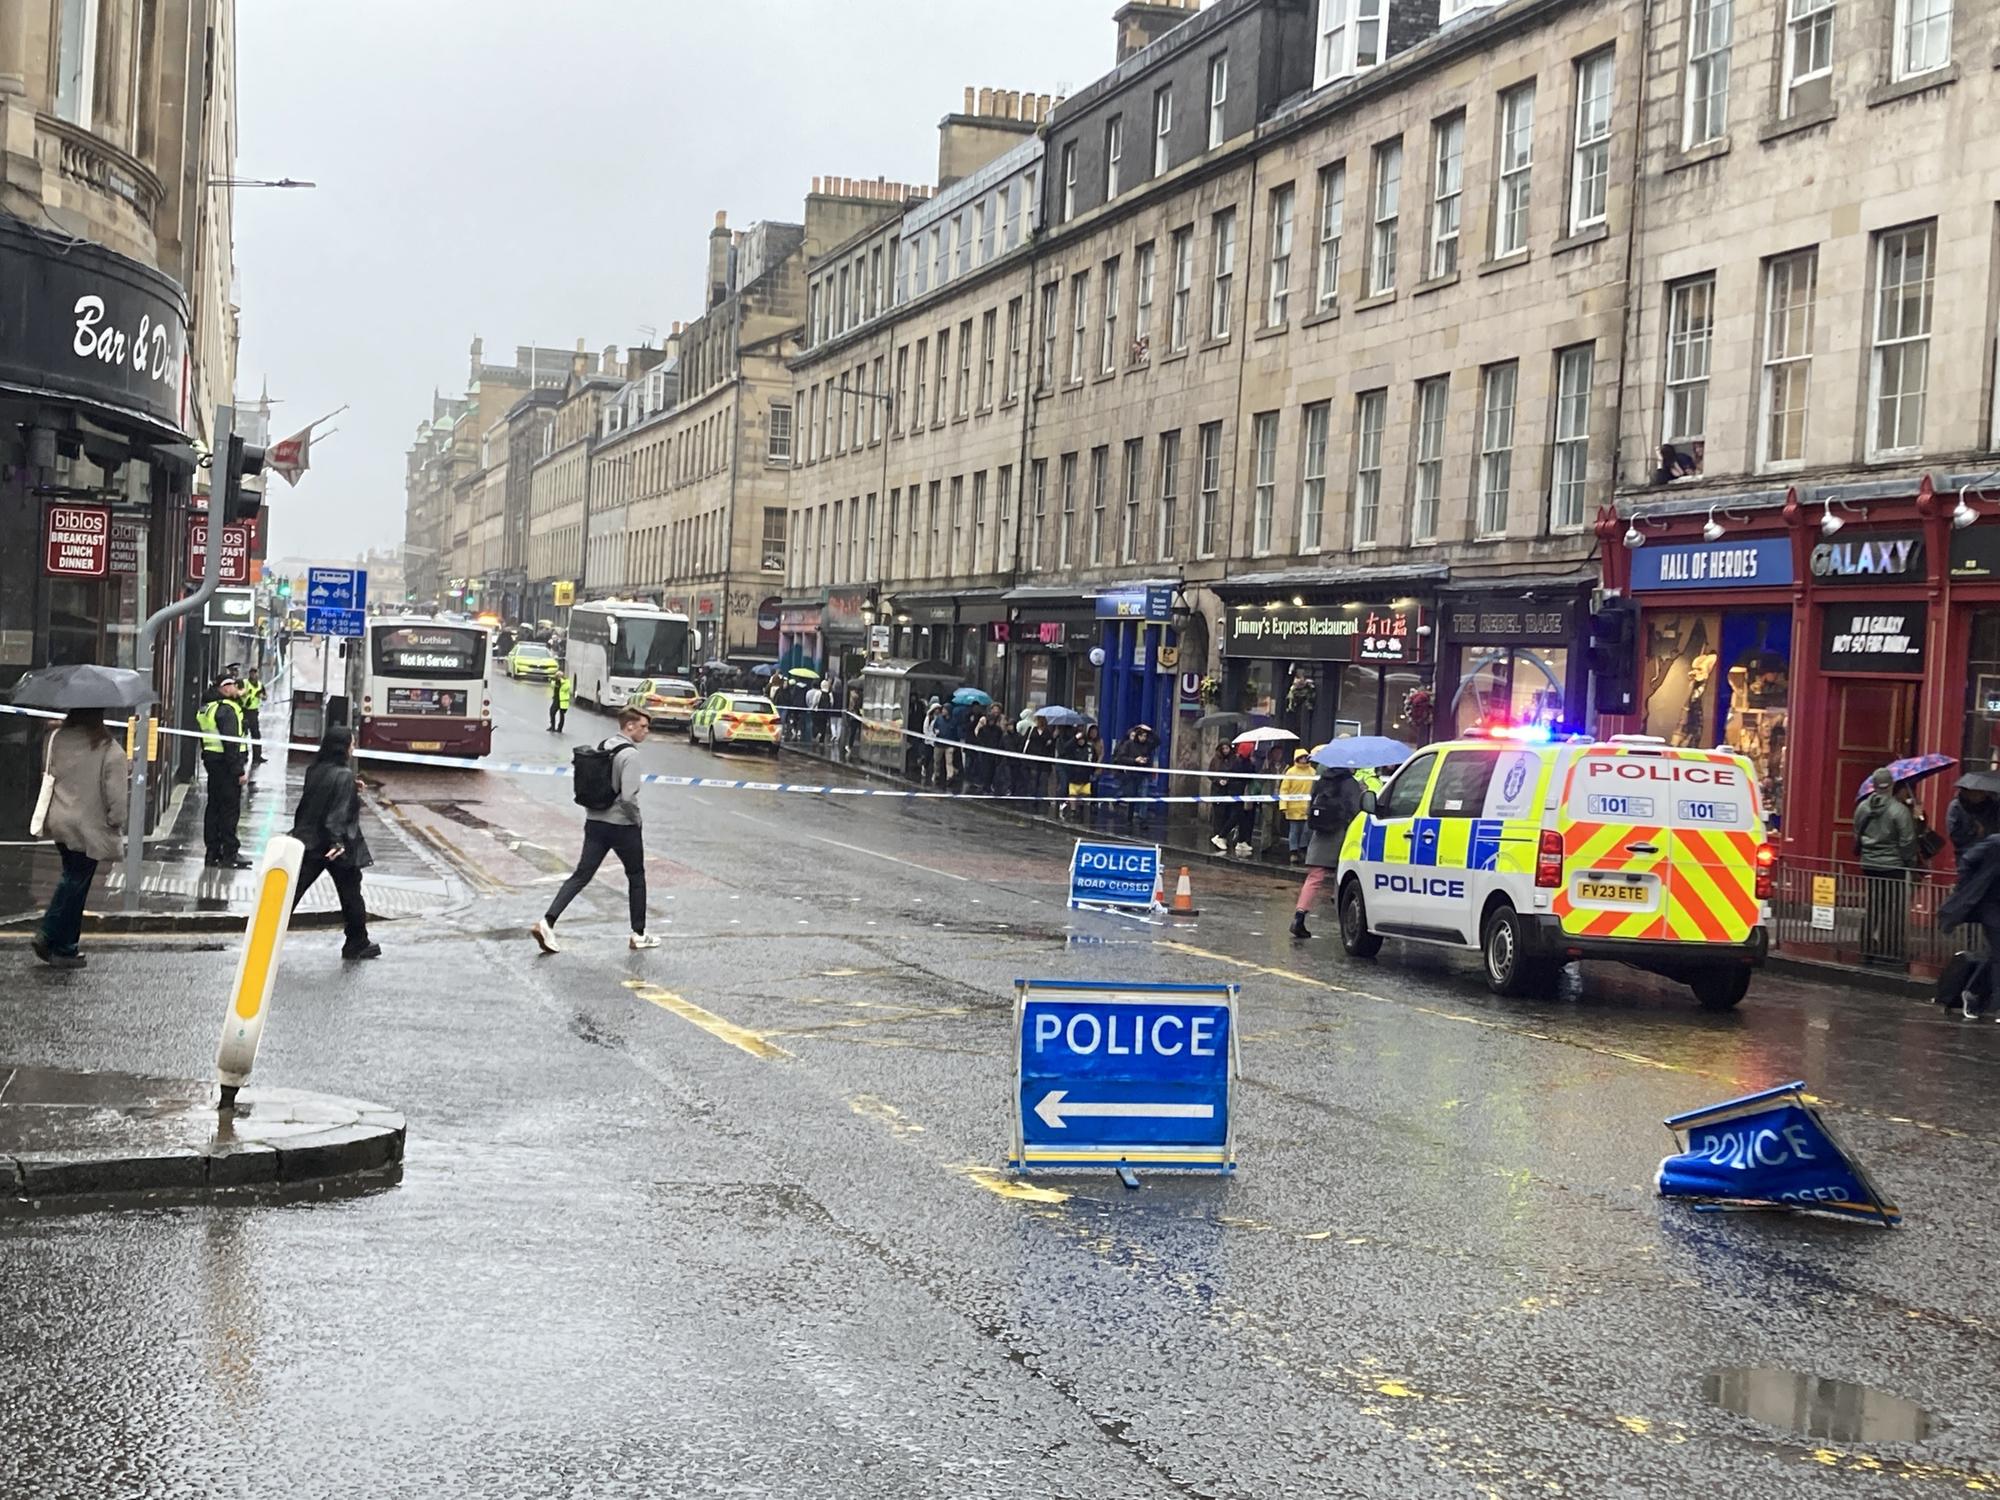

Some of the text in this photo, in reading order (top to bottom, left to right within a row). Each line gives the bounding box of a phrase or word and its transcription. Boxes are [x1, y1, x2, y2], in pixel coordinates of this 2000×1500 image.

[73, 295, 125, 365] Bar
[133, 314, 149, 371] &
[55, 511, 102, 530] biblos
[51, 531, 104, 546] BREAKFAST
[196, 528, 242, 544] bos
[61, 545, 93, 557] LUNCH
[192, 545, 245, 557] BRFAST
[1810, 540, 1914, 576] GALAXY
[59, 557, 94, 570] DINNER
[1660, 549, 1758, 580] HALL OF HEROES
[1234, 617, 1359, 640] Jimmy's Express Restaurant
[1453, 613, 1563, 633] THE REBEL BASE
[420, 636, 451, 645] Lothian
[1851, 635, 1866, 653] SO
[400, 653, 416, 666] Not
[426, 654, 458, 668] Service
[1590, 762, 1736, 786] POLICE
[1600, 797, 1627, 813] 101
[1690, 803, 1714, 818] 101
[1081, 852, 1152, 873] POLICE
[1077, 878, 1150, 892] ROAD CLOSED
[1375, 873, 1464, 898] POLICE
[1582, 884, 1643, 900] FV23 ETE
[1035, 1013, 1215, 1056] POLICE
[1696, 1124, 1817, 1169] POLICE
